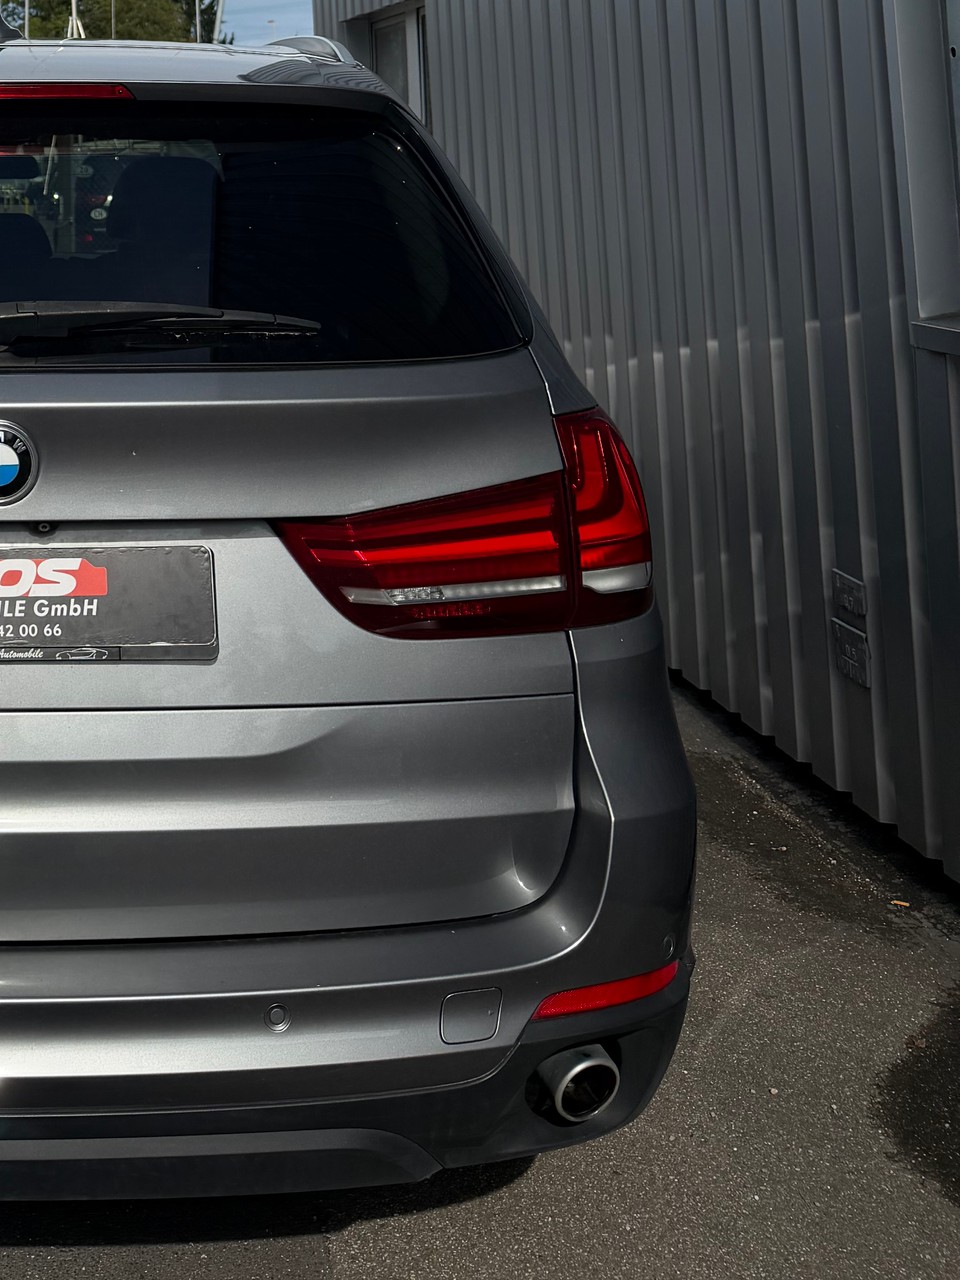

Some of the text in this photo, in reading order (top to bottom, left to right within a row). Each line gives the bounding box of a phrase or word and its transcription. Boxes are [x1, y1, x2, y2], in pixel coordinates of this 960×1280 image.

[33, 598, 99, 617] GmbH
[19, 624, 38, 637] 00
[43, 623, 62, 637] 66
